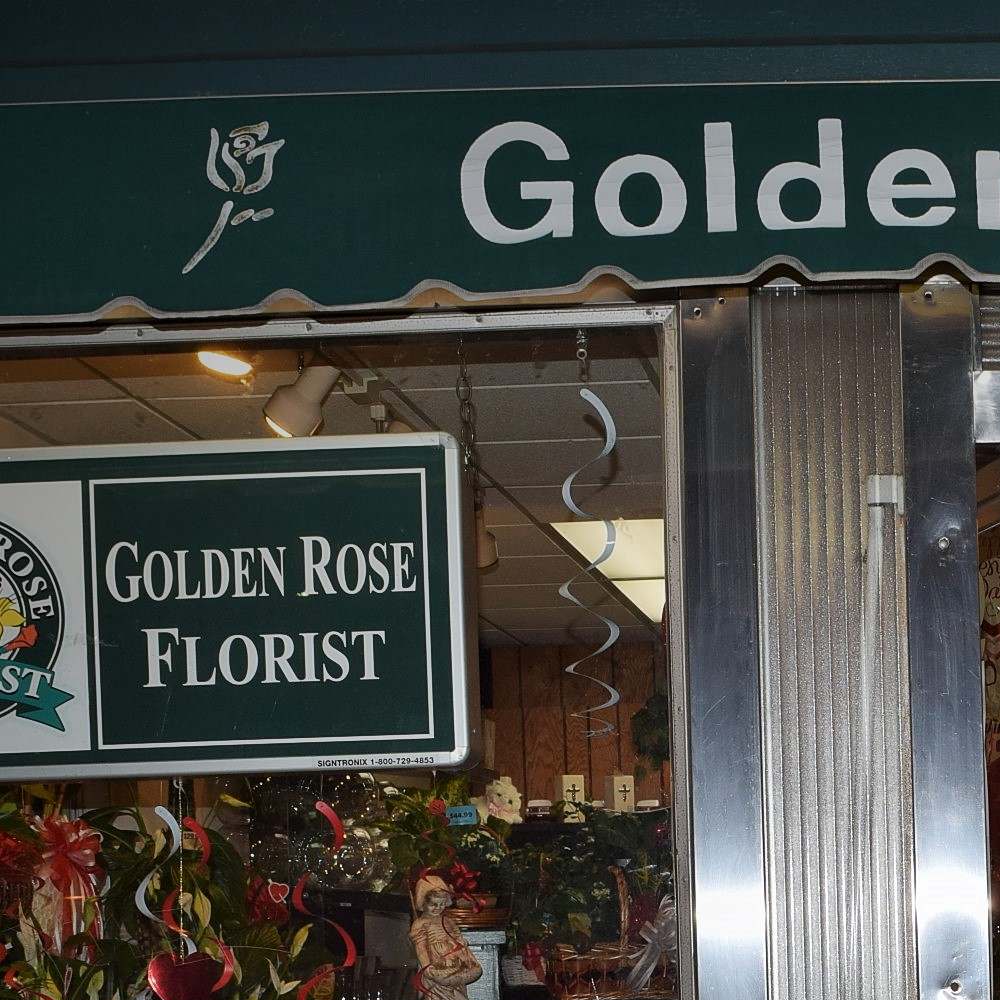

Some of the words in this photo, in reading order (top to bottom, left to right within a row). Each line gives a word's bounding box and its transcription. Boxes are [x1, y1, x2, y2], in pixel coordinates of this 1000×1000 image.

[105, 540, 287, 603] GOLDEN
[299, 535, 417, 596] ROSE
[141, 627, 386, 689] FLORIST
[317, 758, 368, 768] SIGNTRONIX
[370, 756, 434, 766] 1-800-729-4853
